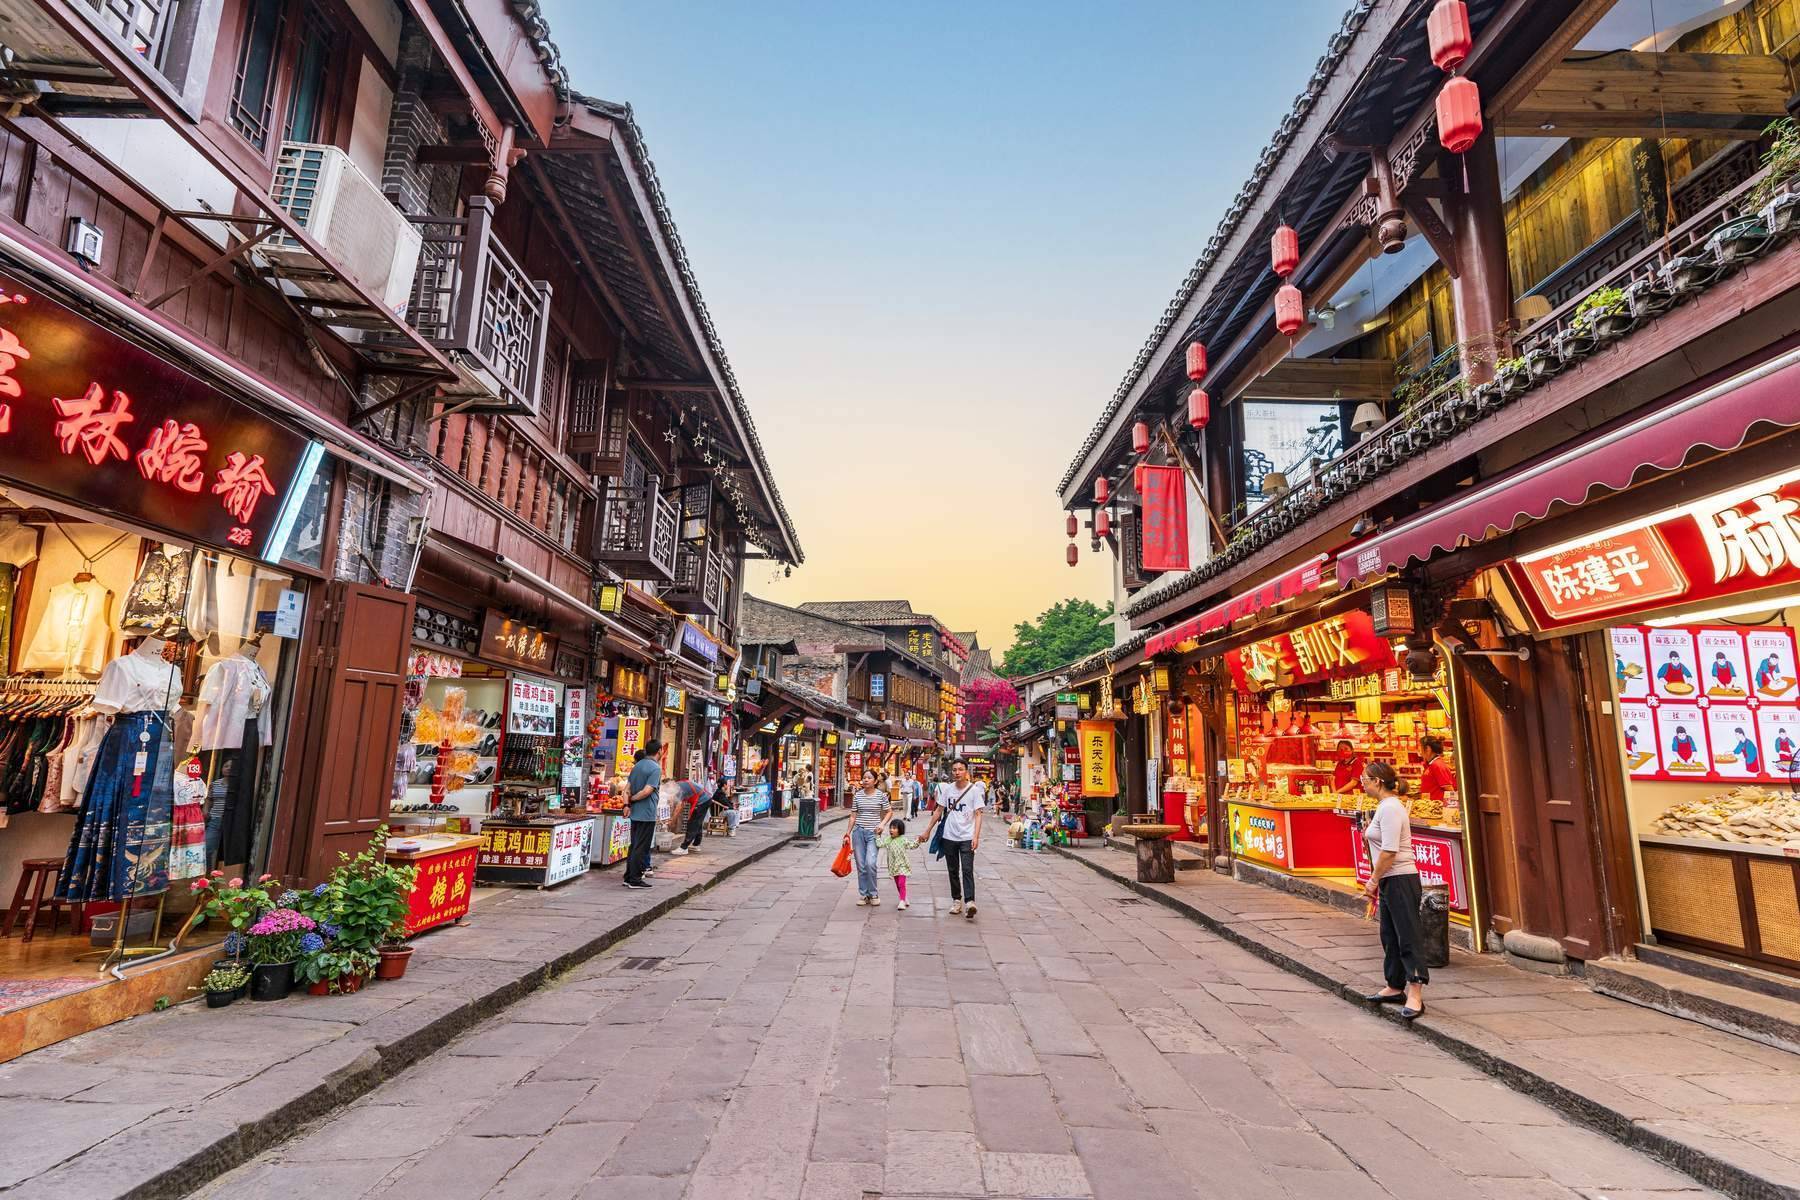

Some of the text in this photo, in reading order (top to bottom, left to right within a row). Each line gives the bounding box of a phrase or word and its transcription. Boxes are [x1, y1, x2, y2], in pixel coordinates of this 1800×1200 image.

[1541, 545, 1650, 605] 陈建平
[922, 632, 932, 657] 老火锅
[514, 683, 555, 703] 西藏鸡血藤
[570, 690, 581, 719] 鸡血藤
[1747, 697, 1759, 709] 平
[622, 718, 639, 756] 血橙汁
[1091, 735, 1104, 786] 乐天茶社
[948, 798, 966, 811] blur
[479, 830, 550, 855] 西藏鸡血藤
[555, 826, 581, 851] 鸡血藤
[1244, 827, 1285, 859] 怪味胡豆
[482, 855, 544, 866] 除湿 活血 避邪
[429, 871, 467, 909] 糖画
